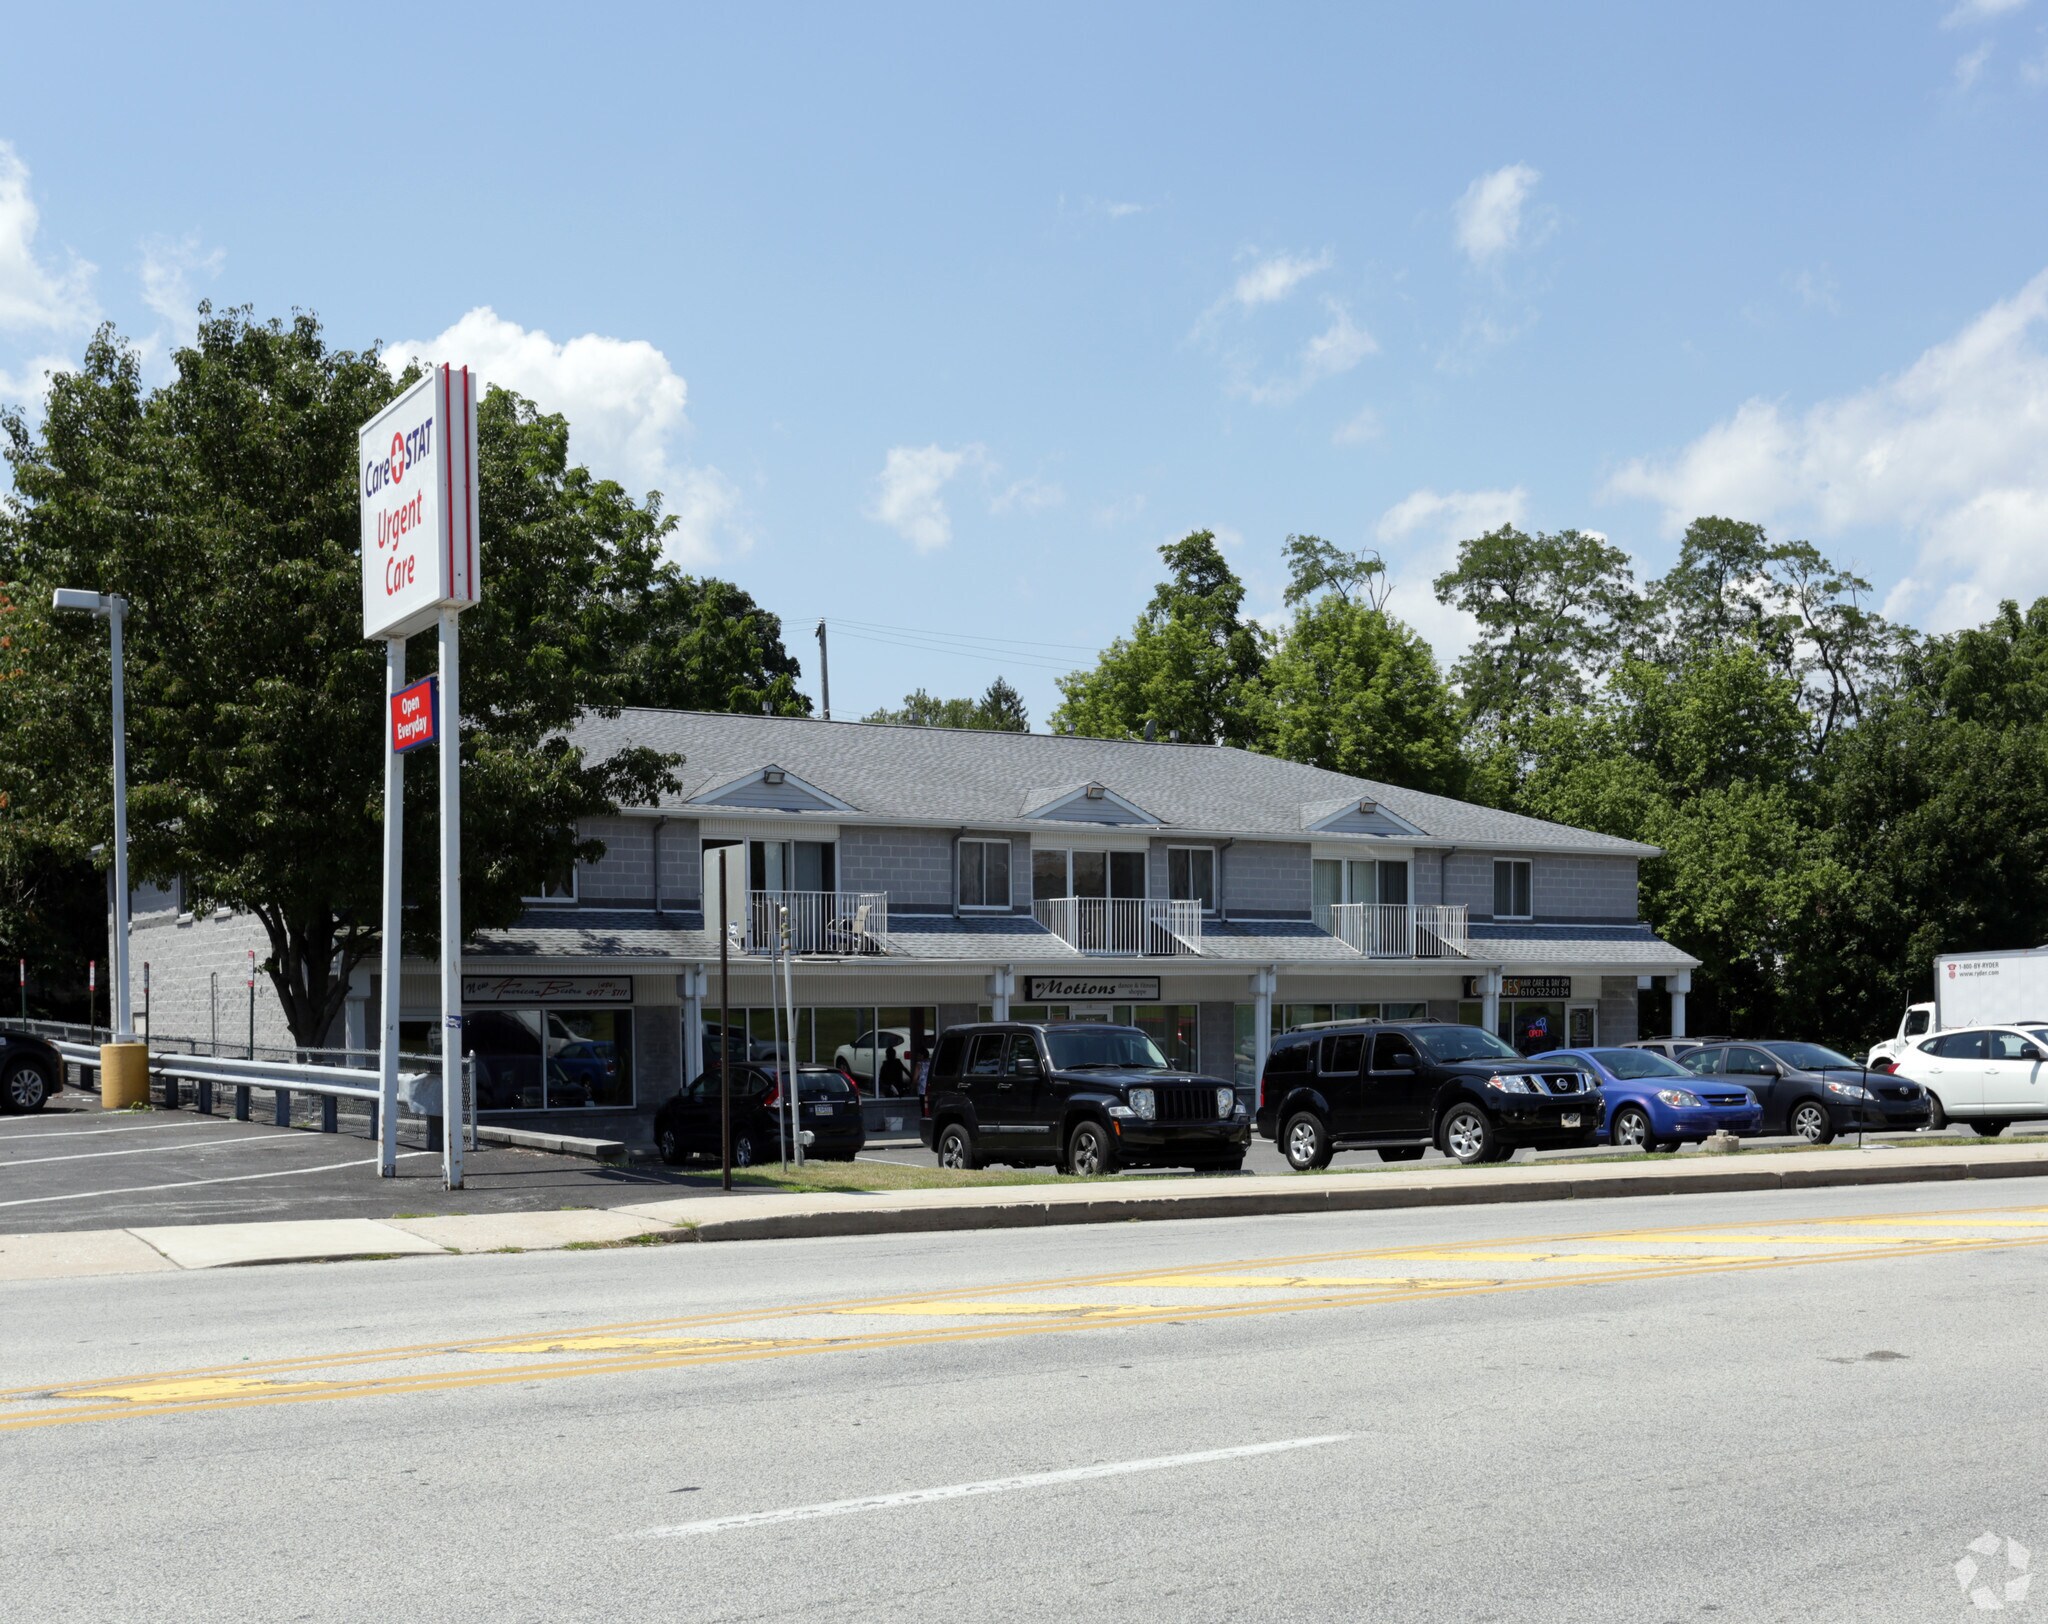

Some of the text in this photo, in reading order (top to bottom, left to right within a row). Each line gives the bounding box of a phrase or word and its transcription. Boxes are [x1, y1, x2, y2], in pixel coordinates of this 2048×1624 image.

[366, 417, 433, 498] Care STAT
[378, 488, 422, 551] Urgent
[386, 554, 415, 596] Care
[401, 696, 420, 717] Open
[397, 714, 427, 740] Everyday
[1521, 979, 1531, 987] HAIR
[1532, 979, 1544, 987] CARE
[1545, 979, 1550, 987] &
[1561, 979, 1570, 987] SPA
[1959, 970, 2000, 978] www.ryder.com
[491, 977, 540, 1000] American
[536, 980, 582, 998] Bistro
[1037, 980, 1116, 998] Motions
[1520, 987, 1569, 996] 610-522-0134
[1528, 1029, 1544, 1038] OPEN
